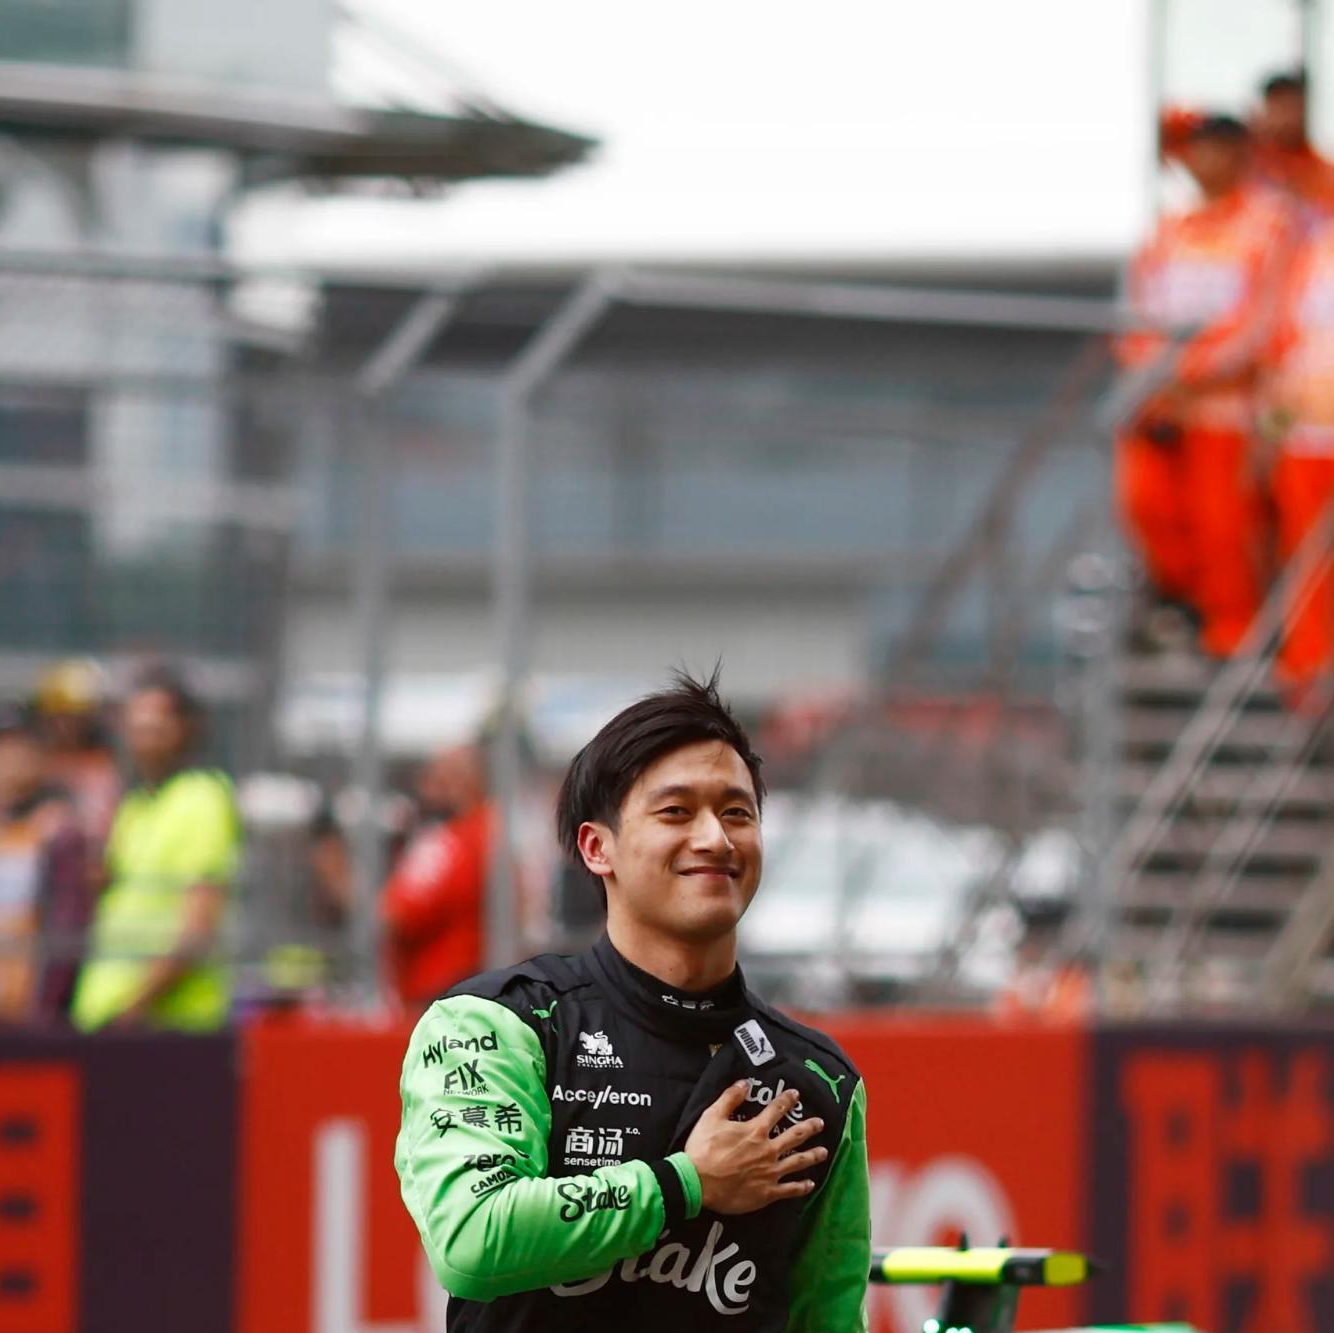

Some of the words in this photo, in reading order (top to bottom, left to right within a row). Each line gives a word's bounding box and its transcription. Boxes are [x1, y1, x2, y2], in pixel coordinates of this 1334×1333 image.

[422, 1030, 499, 1069] Hyland
[736, 1027, 759, 1054] PUMA
[576, 1054, 623, 1066] SINGHA
[443, 1058, 485, 1091] FIX
[442, 1083, 490, 1097] NETWORK
[551, 1084, 652, 1110] Accelleron
[429, 1102, 523, 1138] 安慕希
[565, 1126, 624, 1156] 商汤
[563, 1157, 622, 1168] sensetime
[557, 1179, 632, 1223] Stake
